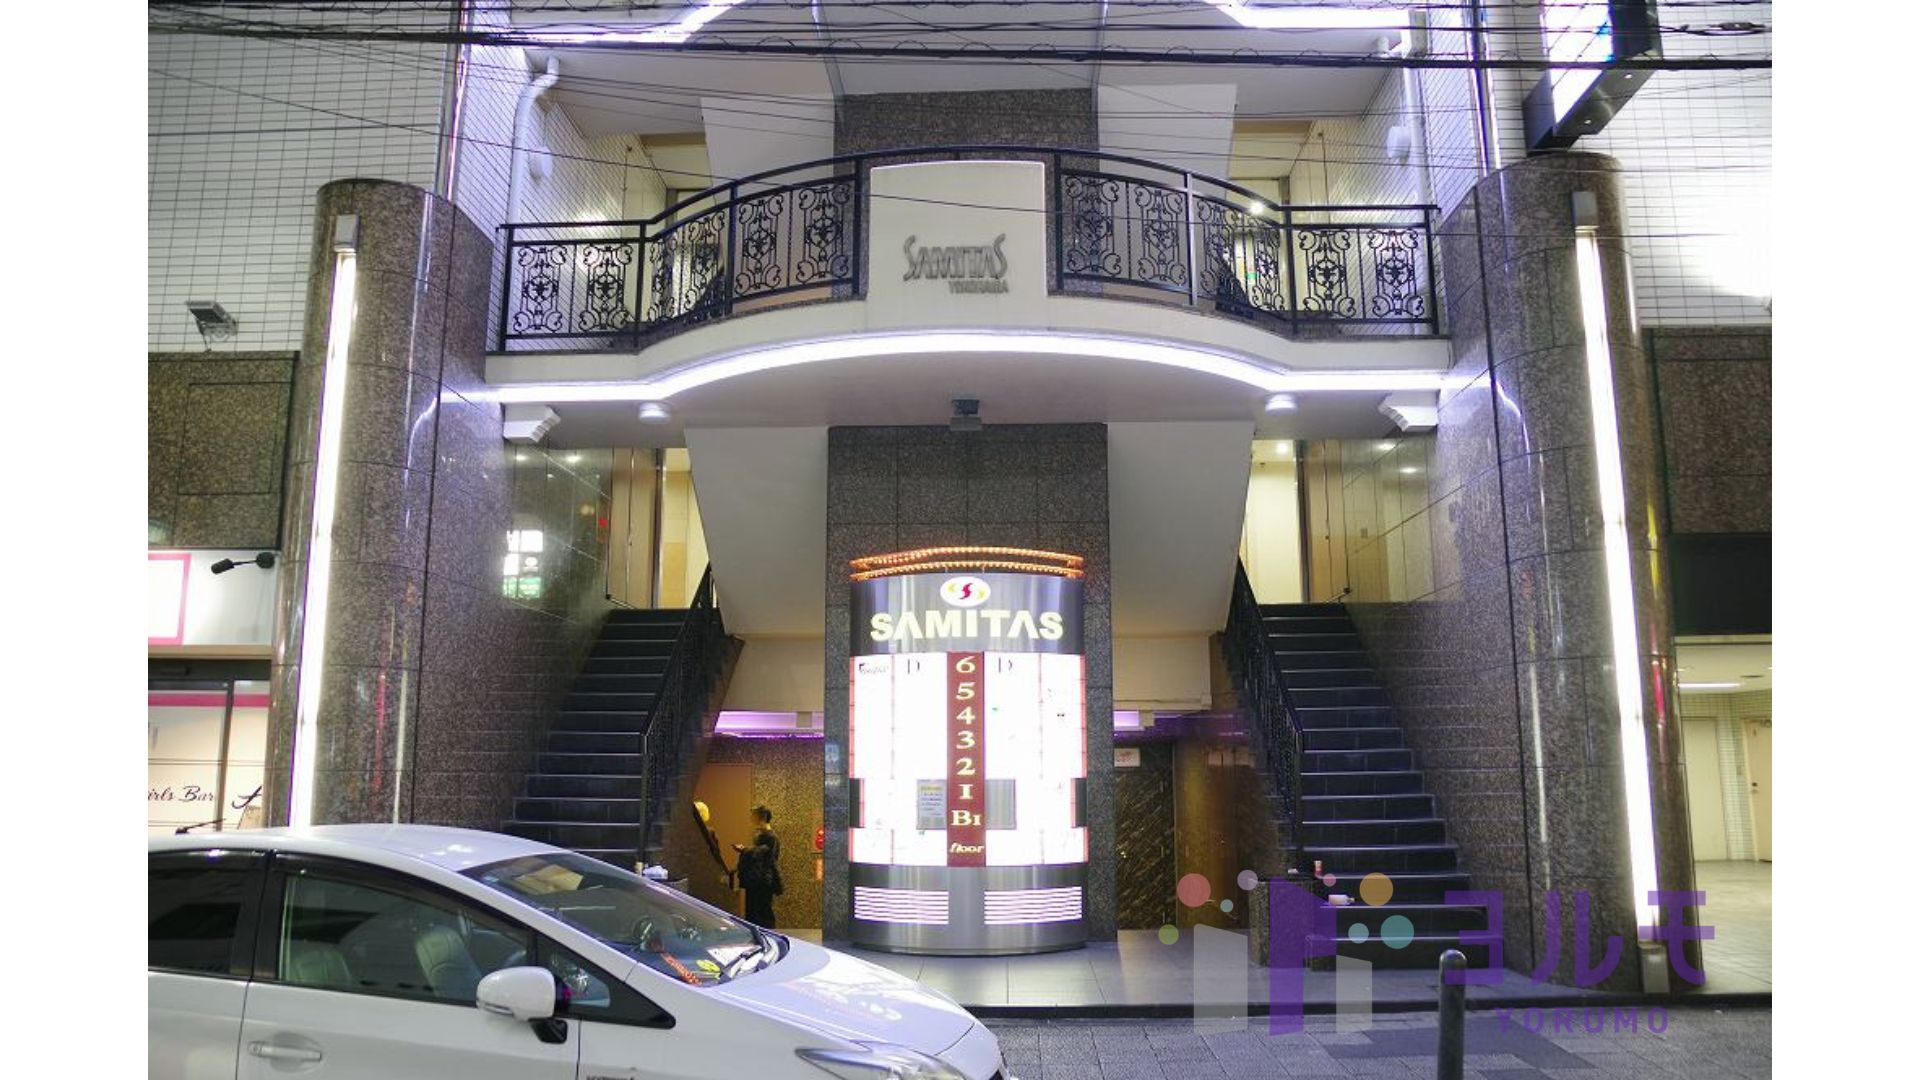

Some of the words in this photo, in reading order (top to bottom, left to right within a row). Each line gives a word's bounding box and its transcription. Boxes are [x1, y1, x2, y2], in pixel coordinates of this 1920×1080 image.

[903, 233, 1008, 281] SAMITAS
[870, 609, 1064, 641] SAMITAS
[955, 655, 976, 674] 6
[955, 681, 976, 701] 5
[955, 706, 976, 725] 4
[955, 730, 976, 750] 3
[955, 757, 976, 776] 2
[178, 785, 214, 803] Bar
[949, 842, 984, 853] floor
